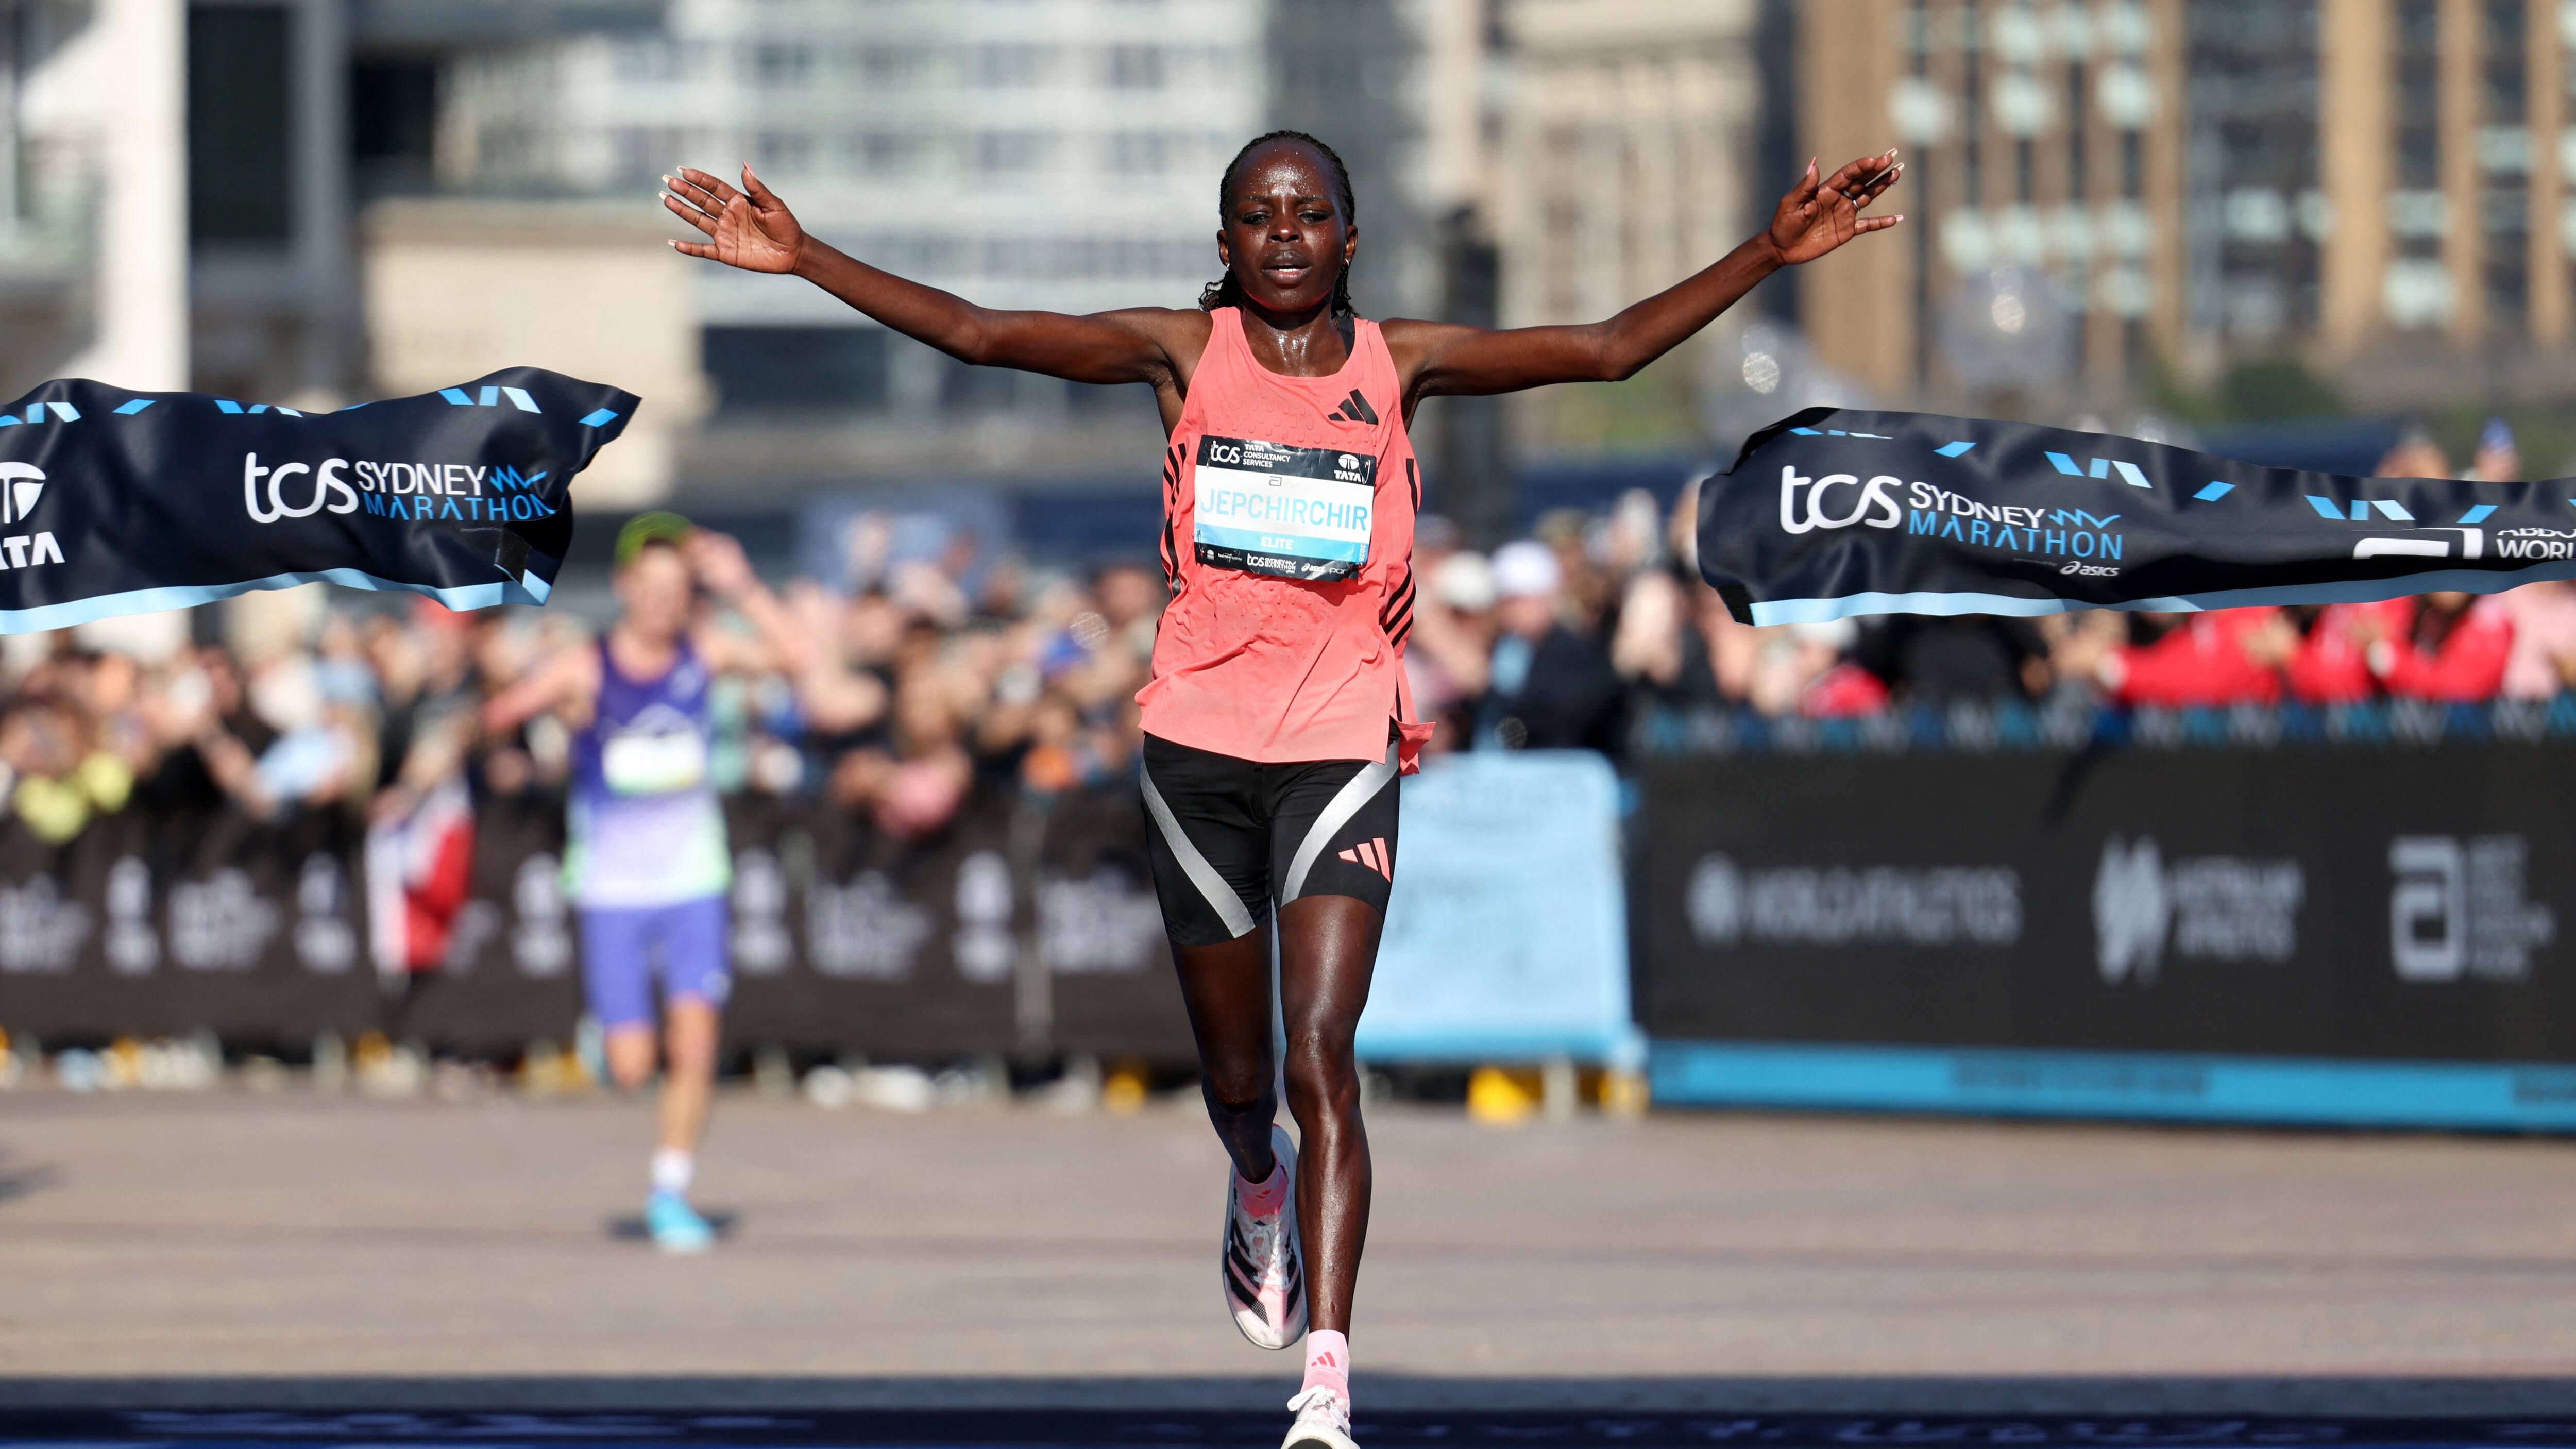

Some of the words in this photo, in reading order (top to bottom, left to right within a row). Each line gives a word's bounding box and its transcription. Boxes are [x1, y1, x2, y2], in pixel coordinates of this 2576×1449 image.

[1211, 440, 1241, 464] tcs
[1243, 451, 1291, 462] CONSULTANCY
[1244, 444, 1265, 452] TATA
[1243, 459, 1273, 467] SERVICES
[1334, 470, 1362, 482] TATA
[245, 452, 359, 523] tcs
[355, 461, 487, 496] SYDNEY
[363, 492, 556, 521] MARATHON
[1200, 489, 1368, 531] JEPCHIRCHIR
[1780, 465, 1902, 534] tcs
[1909, 481, 2045, 529] SYDNEY
[1261, 537, 1294, 550] ELITE
[1909, 510, 2122, 560] MARATHON
[1265, 562, 1296, 570] MARATHON
